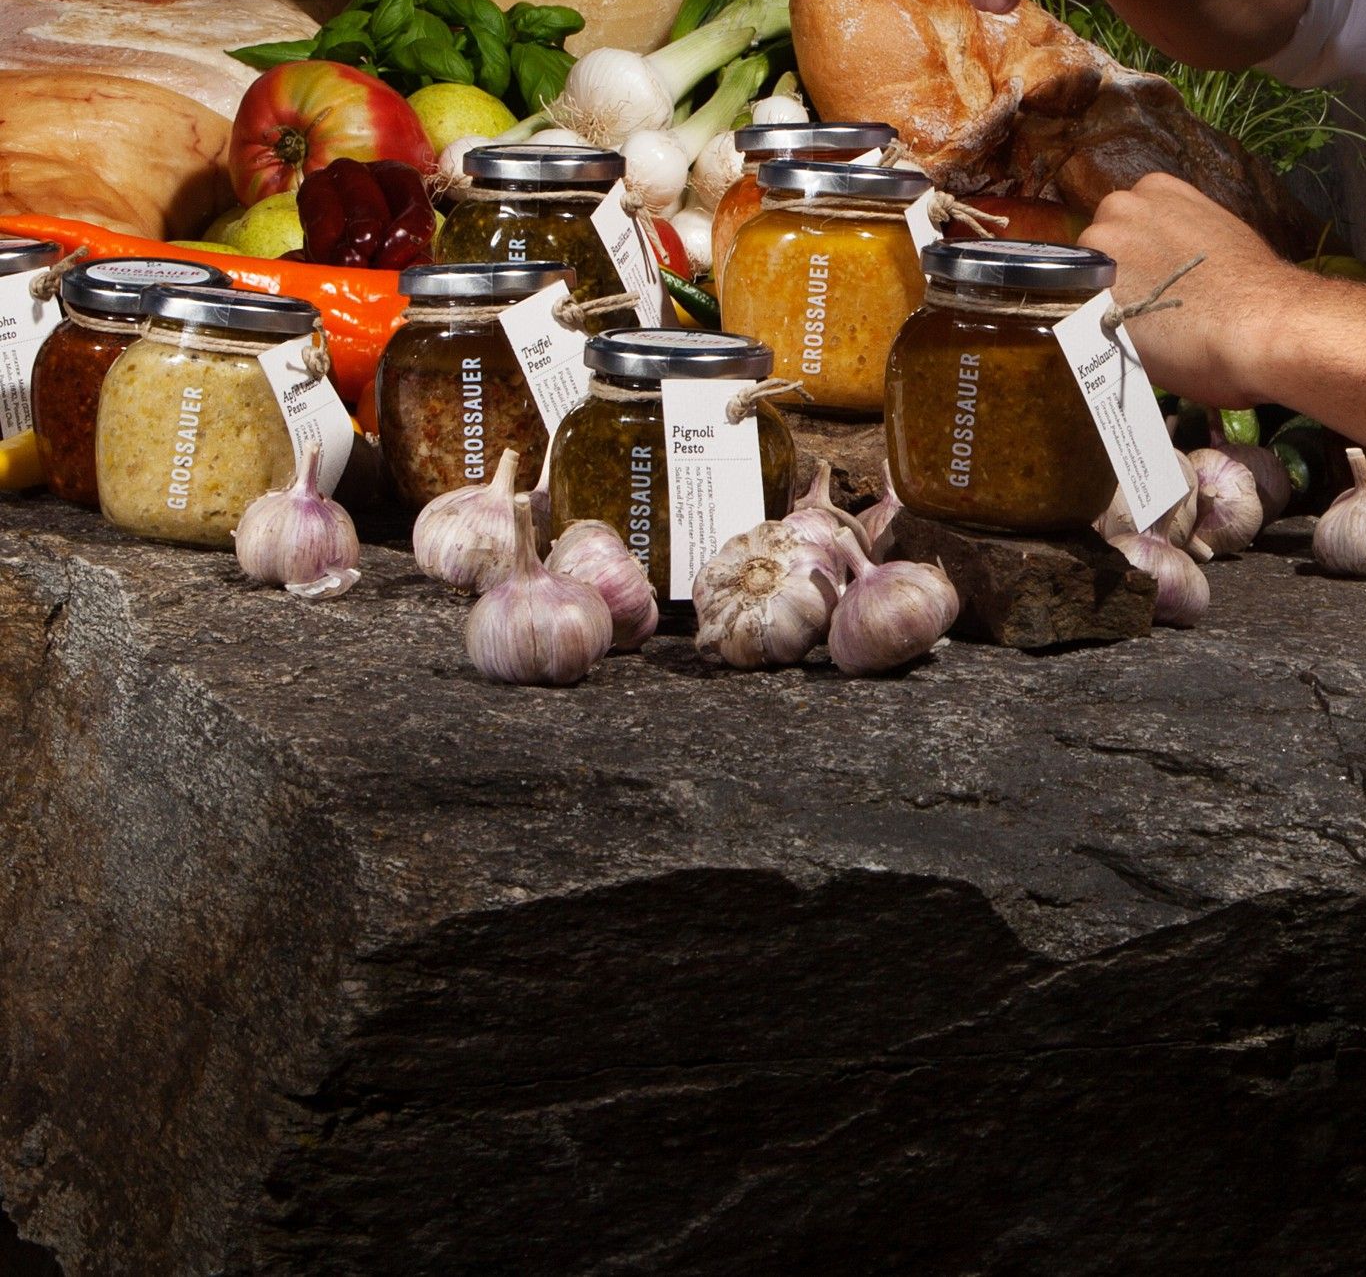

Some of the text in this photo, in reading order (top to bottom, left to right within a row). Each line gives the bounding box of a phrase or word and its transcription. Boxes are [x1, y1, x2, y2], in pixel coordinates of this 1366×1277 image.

[802, 254, 830, 375] GROSSAUER
[521, 335, 552, 359] Trüffel
[527, 355, 552, 373] Pesto
[1077, 341, 1119, 380] Knoblauch
[1084, 374, 1106, 395] Pesto
[286, 401, 307, 417] Pesto
[462, 357, 485, 479] GROSSAUER
[950, 353, 981, 488] GROSSAUER
[672, 425, 714, 442] Pignoli
[167, 387, 204, 510] GROSSAUER
[673, 442, 705, 454] Pesto
